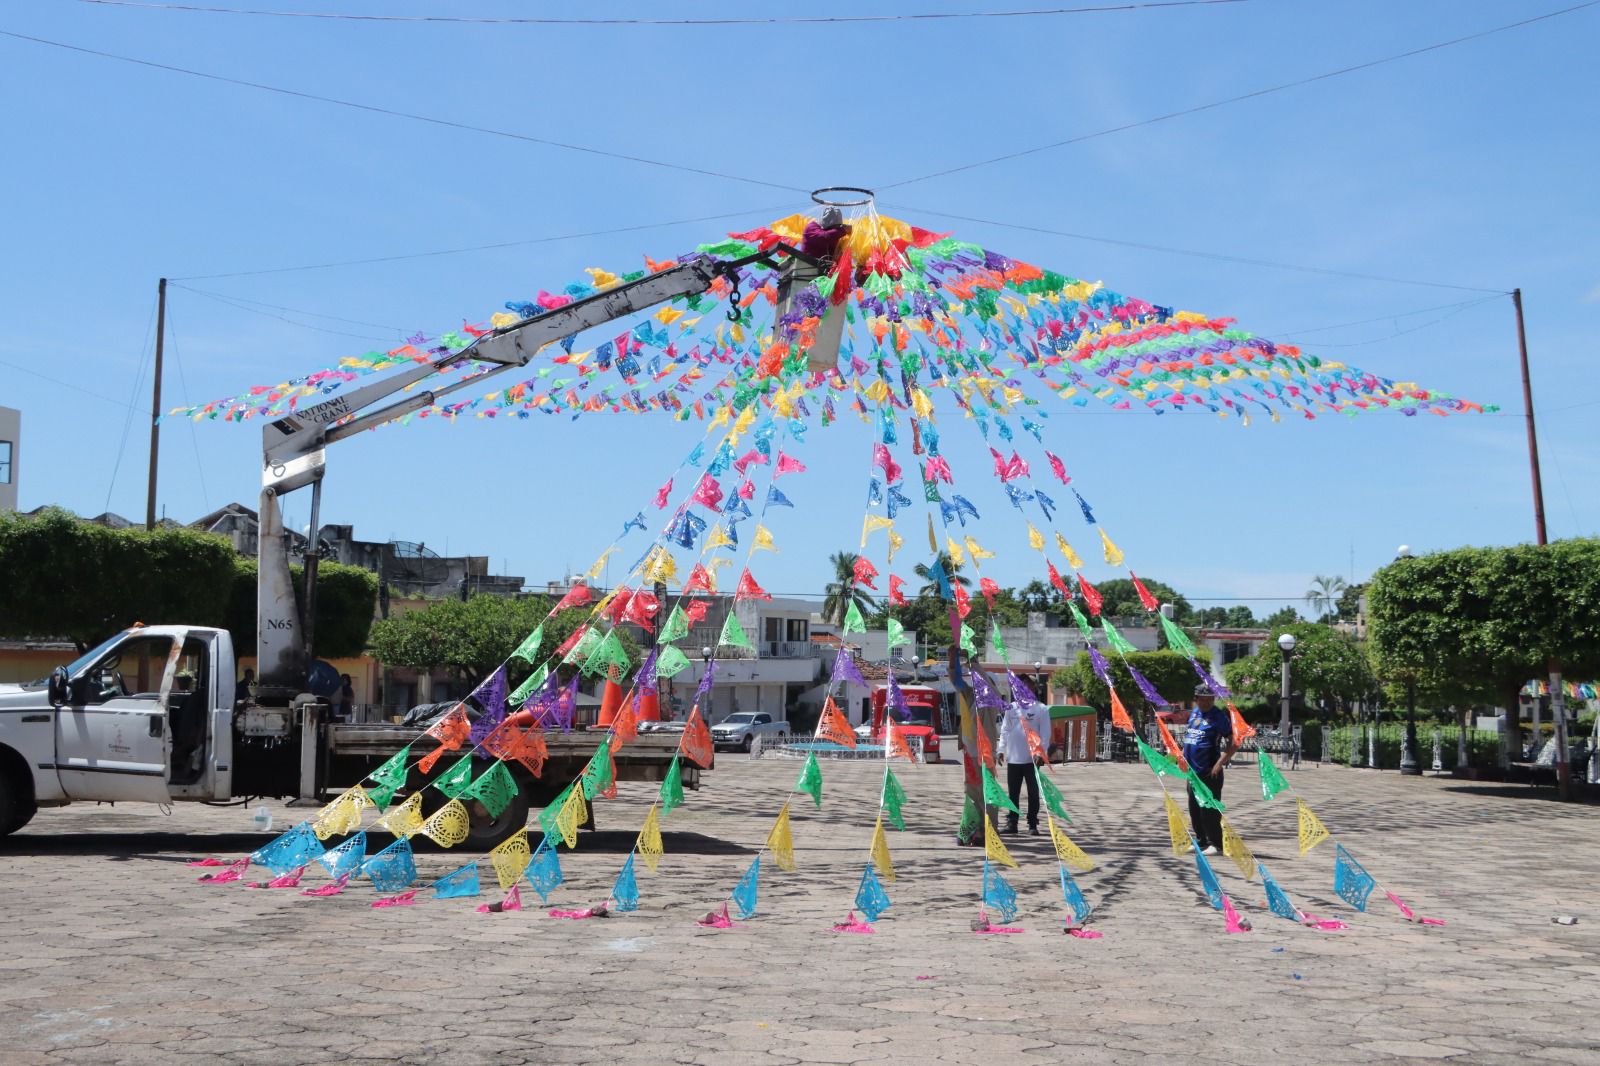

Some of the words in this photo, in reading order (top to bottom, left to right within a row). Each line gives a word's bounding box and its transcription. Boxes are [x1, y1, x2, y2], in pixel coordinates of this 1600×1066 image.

[296, 395, 348, 421] NATIONAL
[313, 403, 352, 424] CRANE
[266, 619, 293, 630] N65
